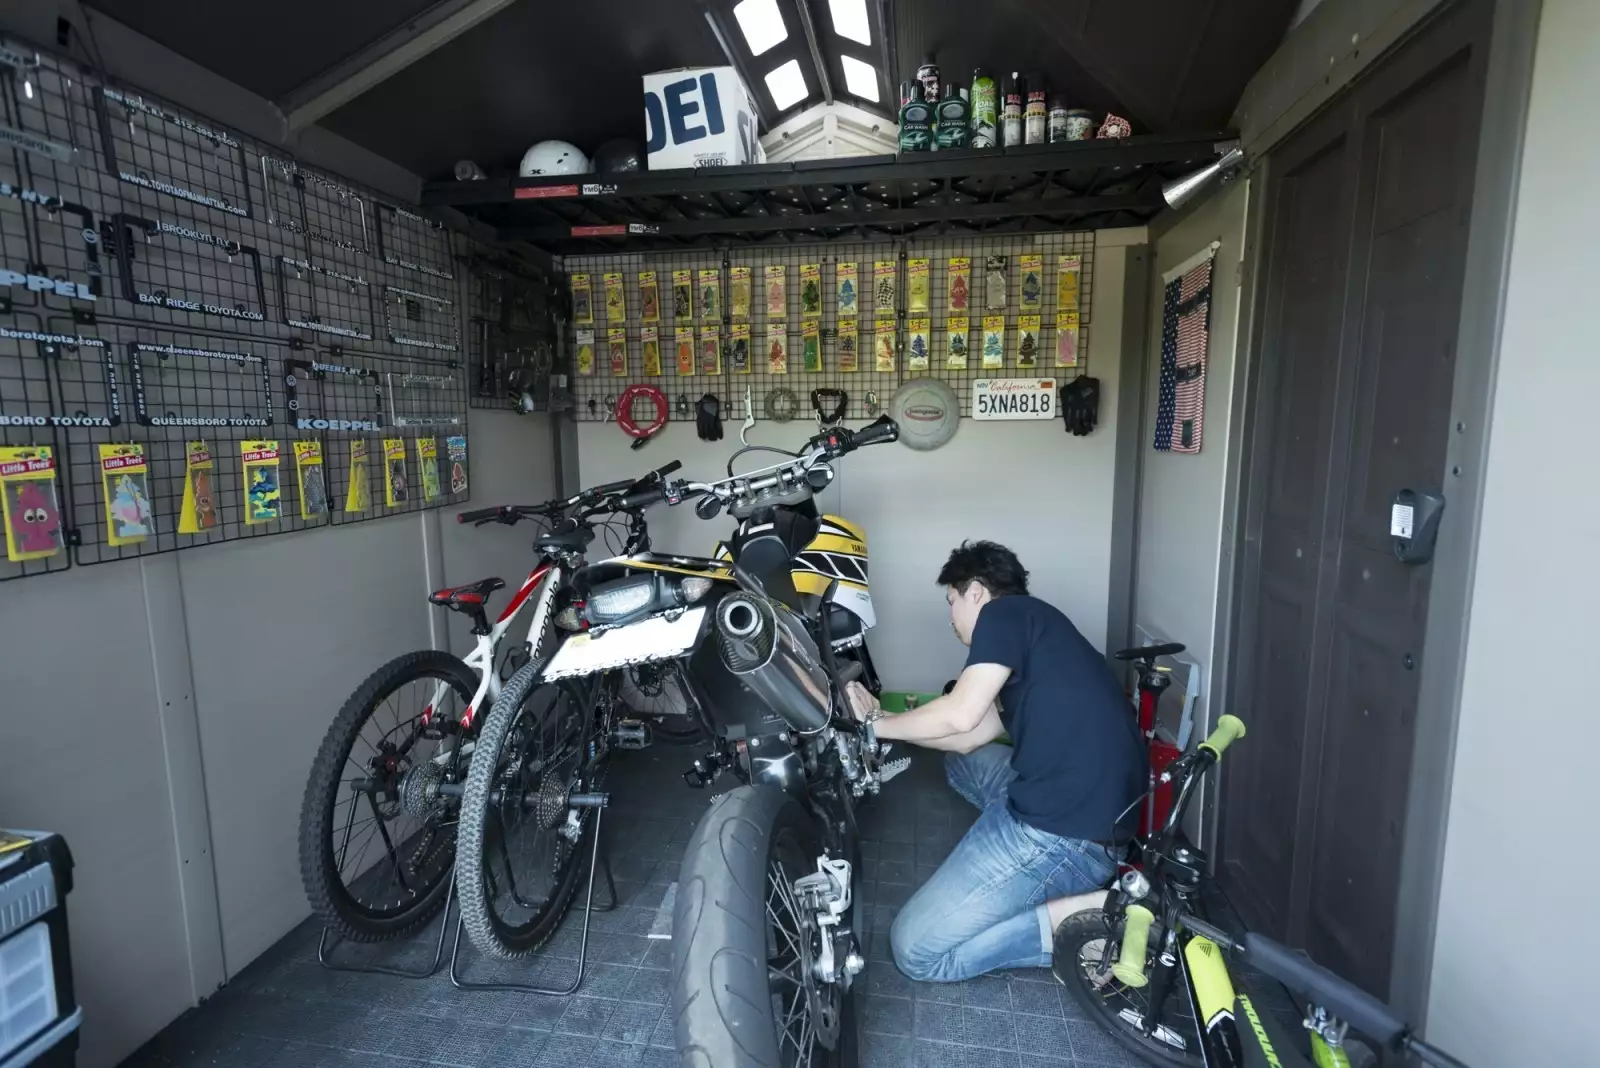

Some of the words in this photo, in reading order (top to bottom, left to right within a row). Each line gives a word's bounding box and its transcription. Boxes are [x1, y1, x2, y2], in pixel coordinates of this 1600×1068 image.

[699, 158, 723, 168] SHOEI
[139, 294, 162, 304] BAY
[166, 298, 199, 310] RIDGE
[204, 304, 263, 320] TOYOTA.COM
[990, 381, 1036, 393] California
[979, 394, 1050, 413] 5XNA818
[0, 416, 46, 425] BORO
[51, 417, 111, 426] TOYOTA
[152, 417, 227, 426] QUEENSBORO
[297, 418, 380, 432] KOEPPEL
[245, 453, 260, 461] Little
[261, 451, 277, 459] Trees
[2, 462, 26, 475] Little
[27, 459, 50, 471] Trees
[105, 459, 124, 468] Little
[125, 457, 142, 465] Trees
